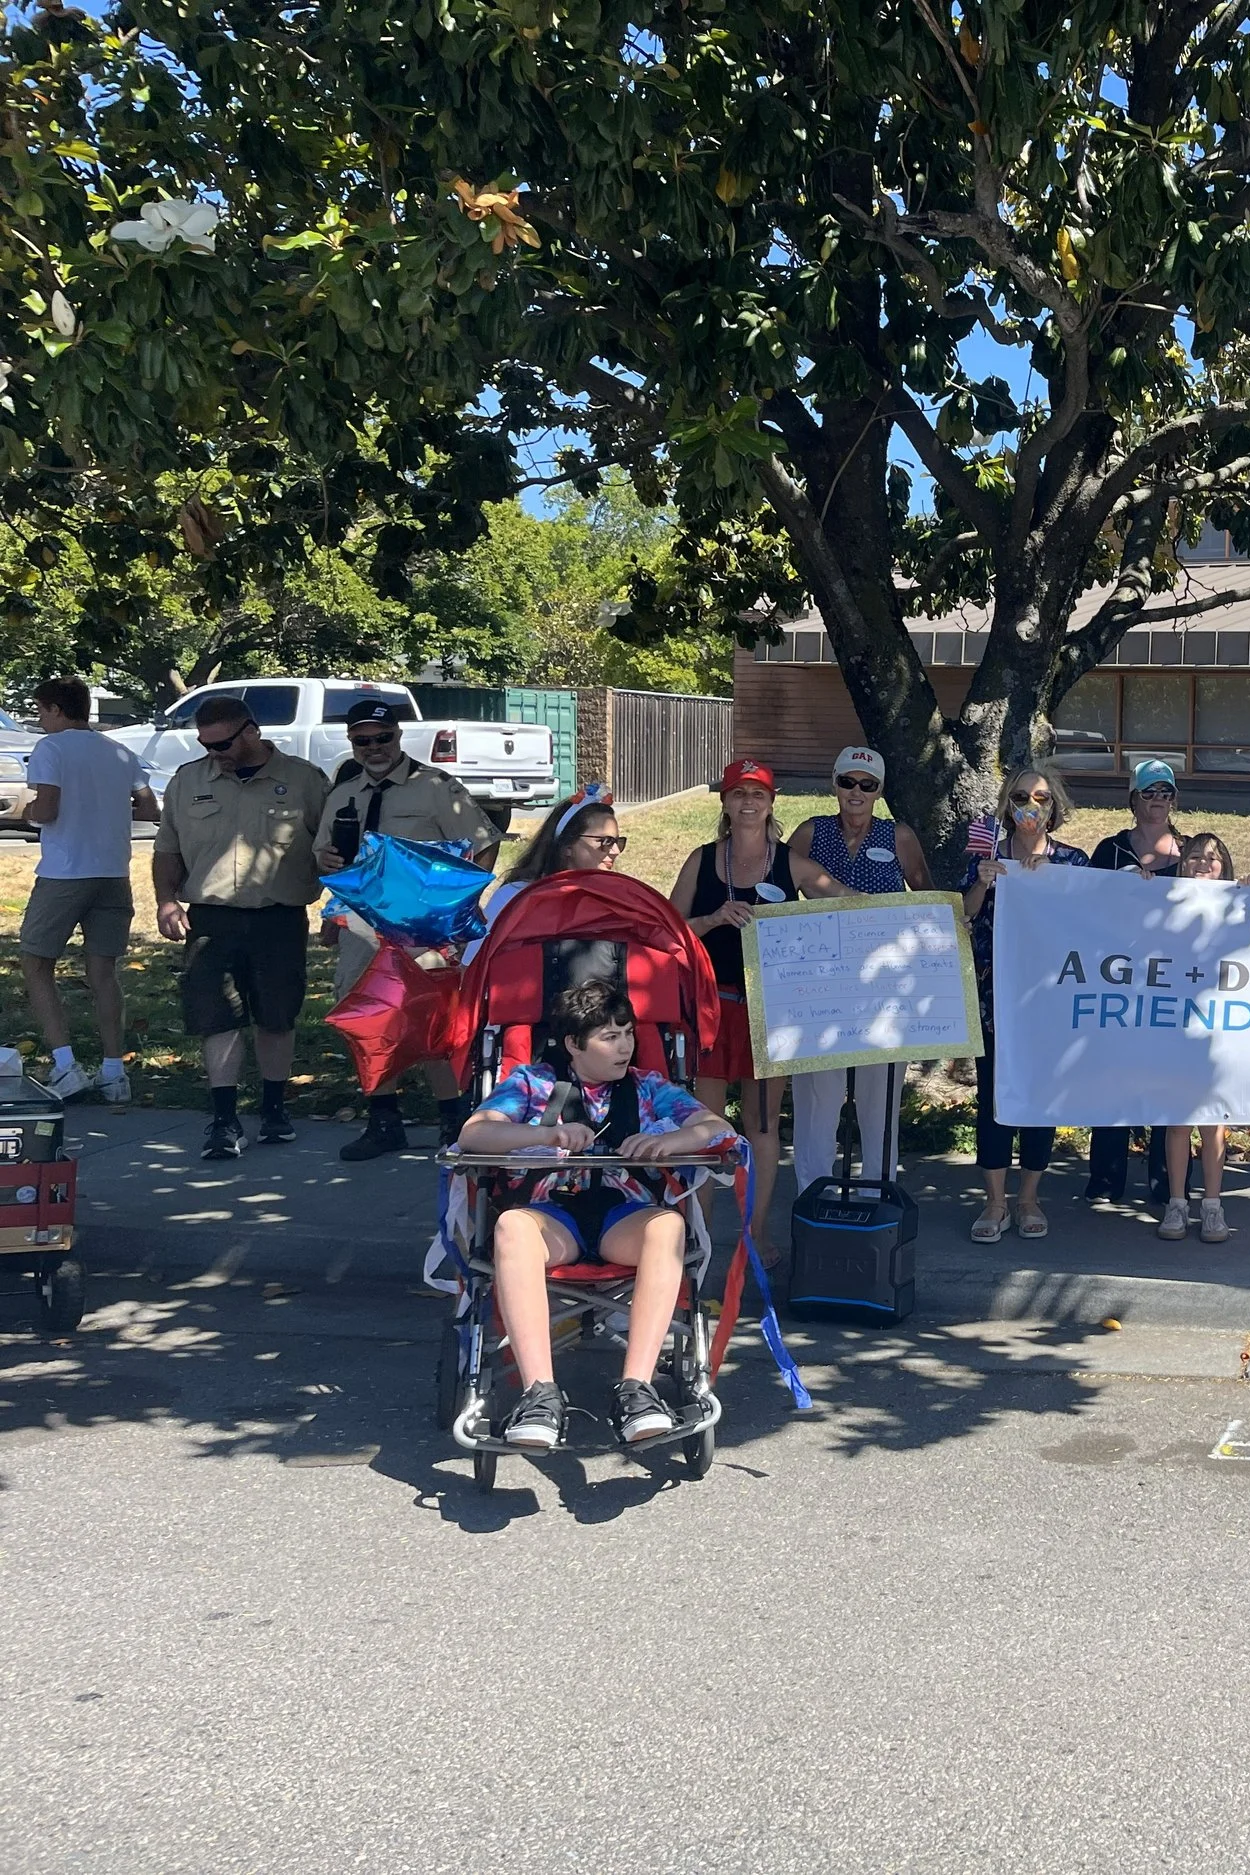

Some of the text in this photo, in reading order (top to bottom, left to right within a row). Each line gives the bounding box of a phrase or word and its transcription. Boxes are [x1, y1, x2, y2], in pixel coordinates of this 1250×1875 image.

[851, 752, 873, 762] GAP
[799, 921, 822, 936] MY
[762, 943, 832, 960] AMERICA
[787, 1008, 803, 1019] No
[808, 1004, 842, 1018] human
